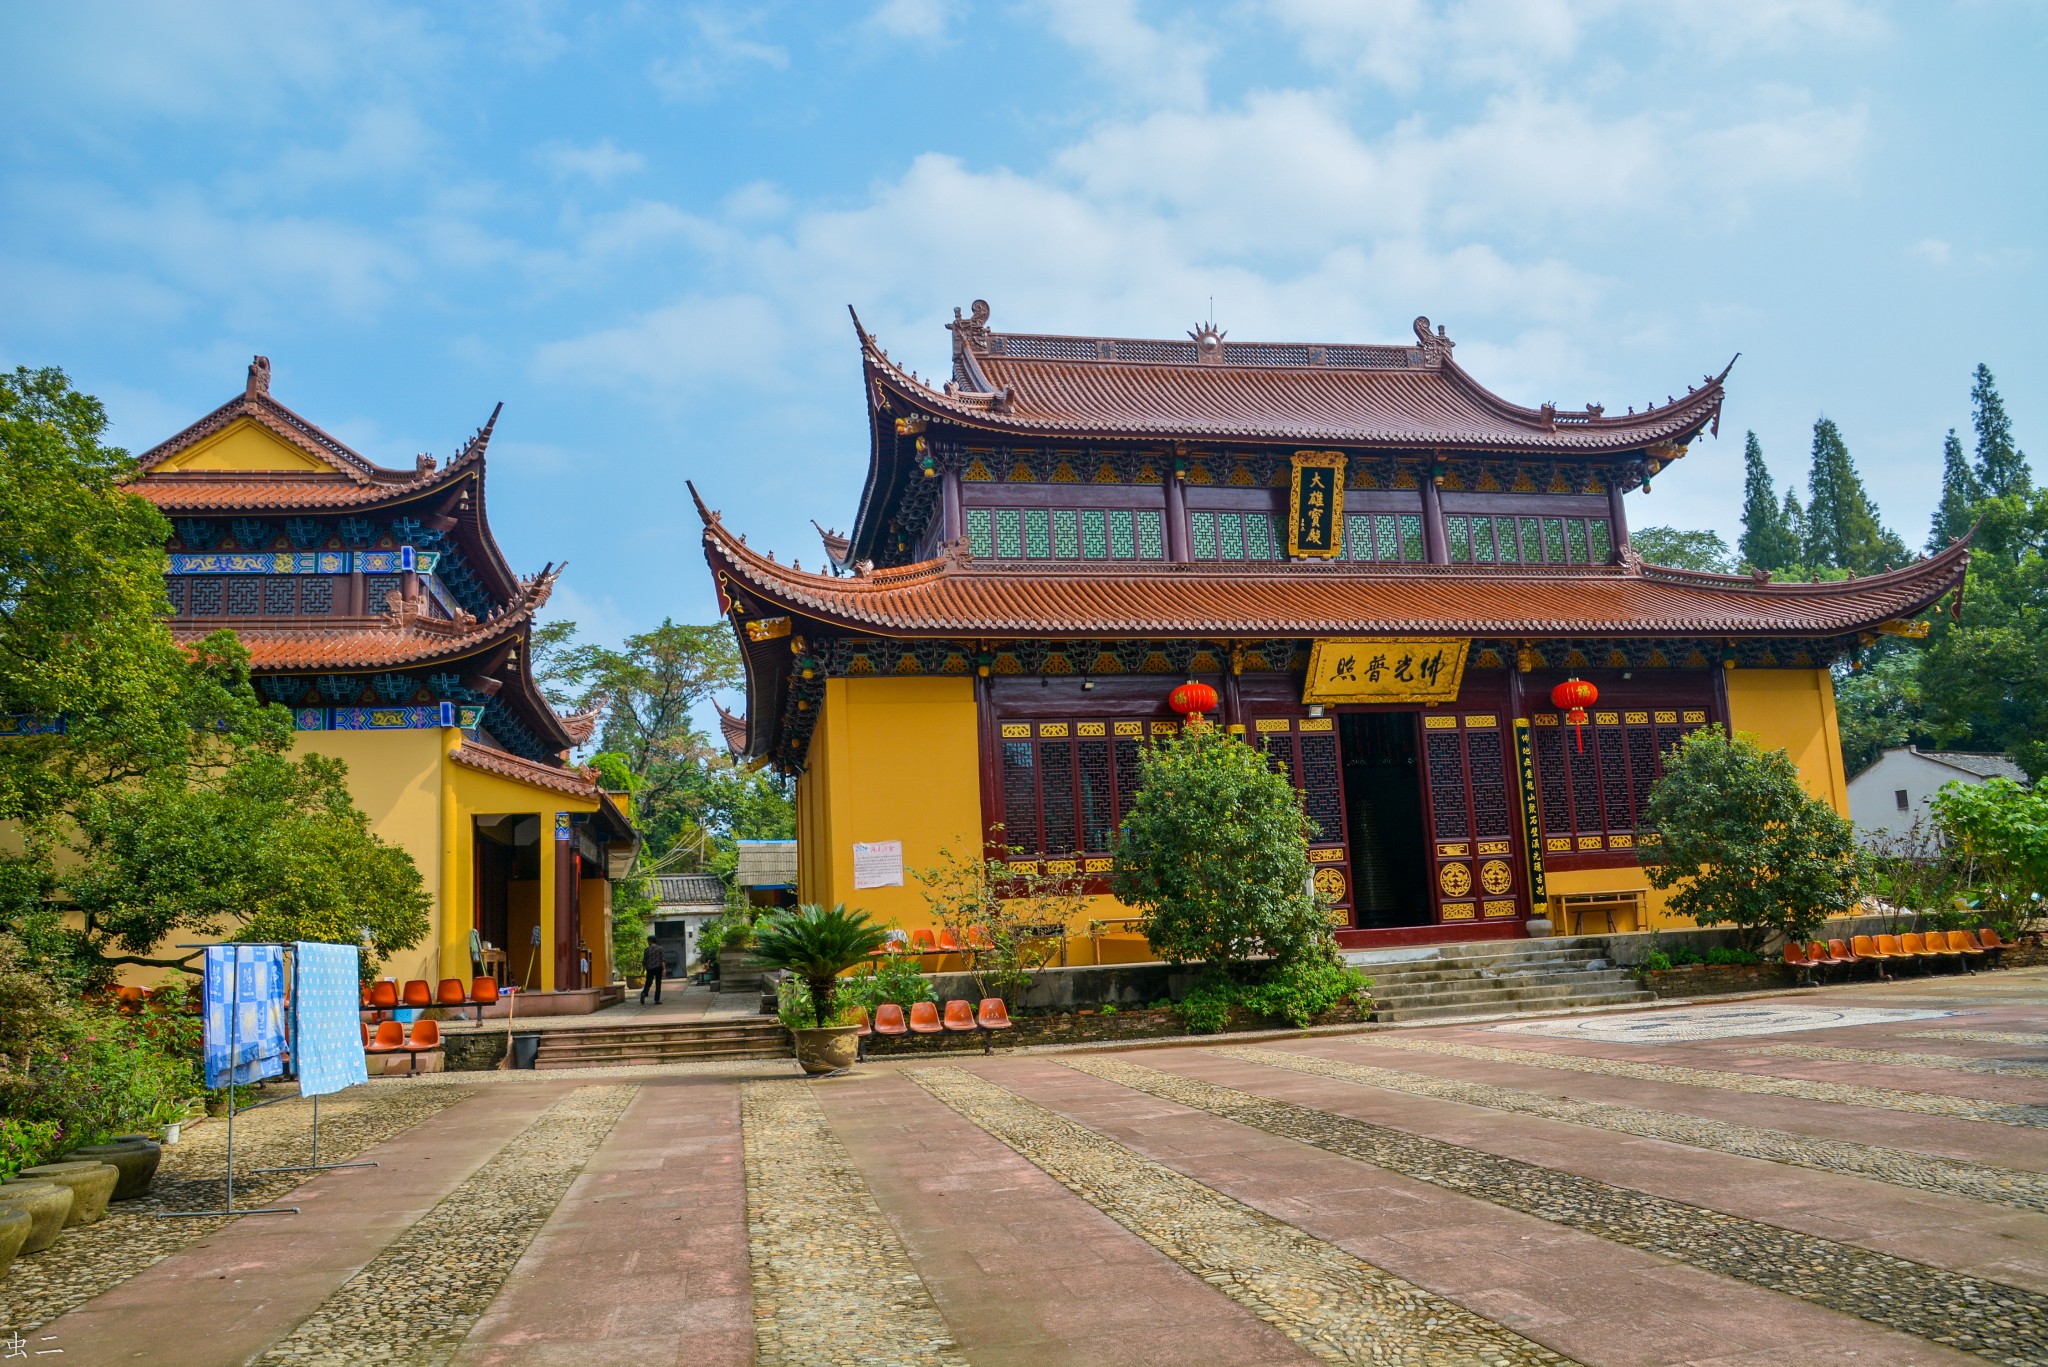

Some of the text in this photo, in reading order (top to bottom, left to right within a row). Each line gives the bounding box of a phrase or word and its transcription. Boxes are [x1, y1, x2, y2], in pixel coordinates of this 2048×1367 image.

[1306, 471, 1325, 545] 大雄寶殿
[1330, 649, 1446, 687] 佛光普照
